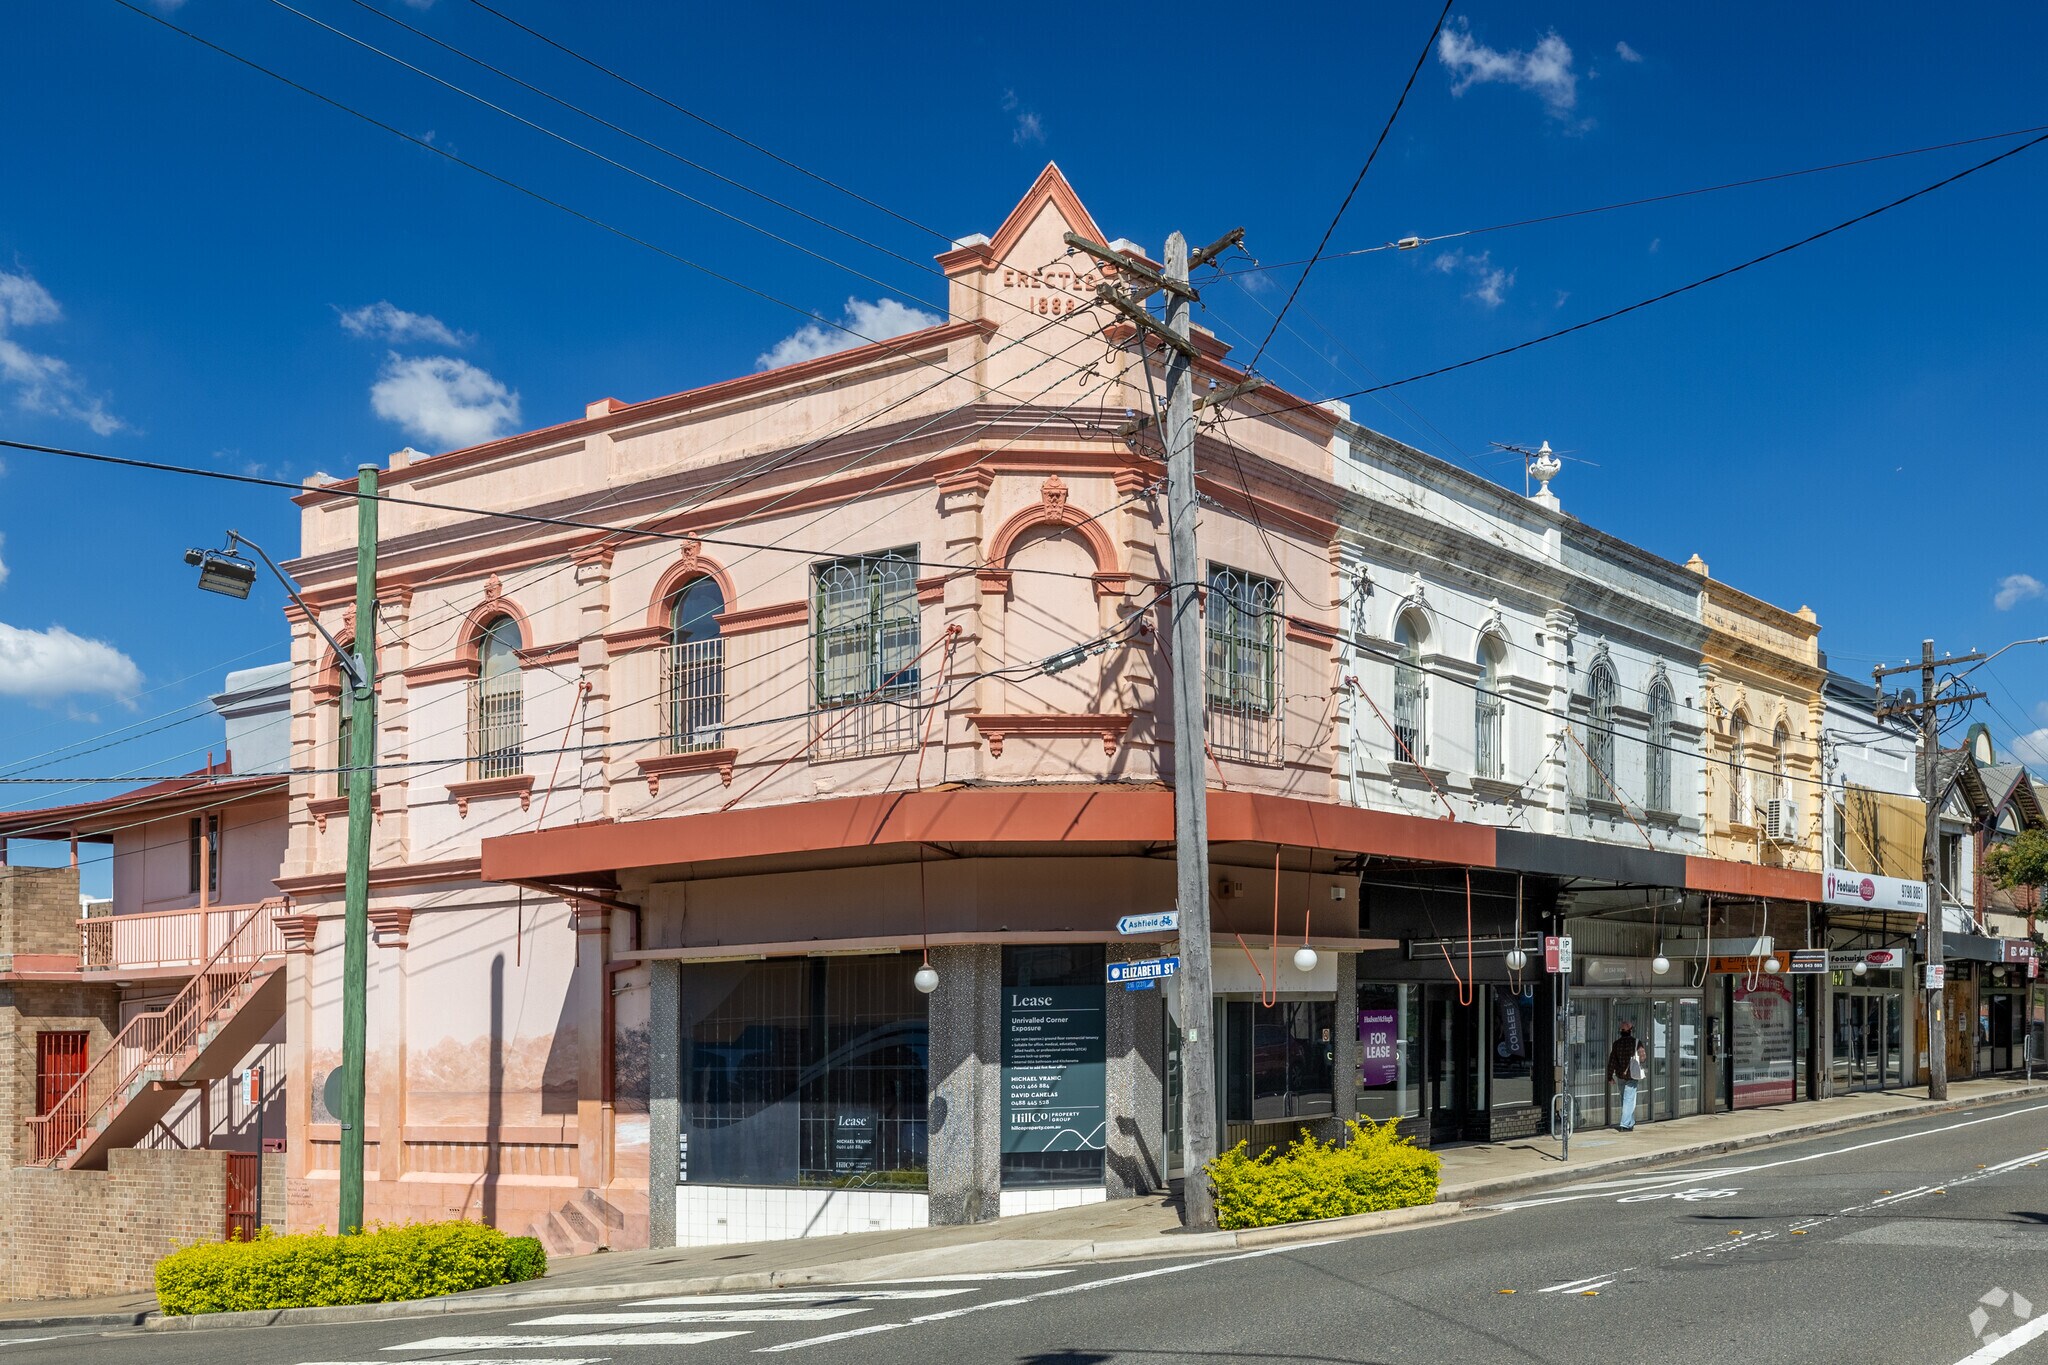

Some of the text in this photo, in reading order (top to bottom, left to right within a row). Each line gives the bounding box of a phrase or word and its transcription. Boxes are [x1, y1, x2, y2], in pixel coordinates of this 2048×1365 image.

[1003, 269, 1097, 292] ERECTED
[1030, 296, 1075, 315] 1888
[1128, 919, 1158, 928] Ashfield
[1122, 964, 1161, 978] ELIZABETH
[1164, 962, 1174, 974] ST
[1012, 994, 1052, 1006] Lease
[1370, 1032, 1386, 1044] FOR
[1367, 1046, 1390, 1058] LEASE
[839, 1116, 866, 1126] Lease
[1012, 1113, 1048, 1123] HillCo
